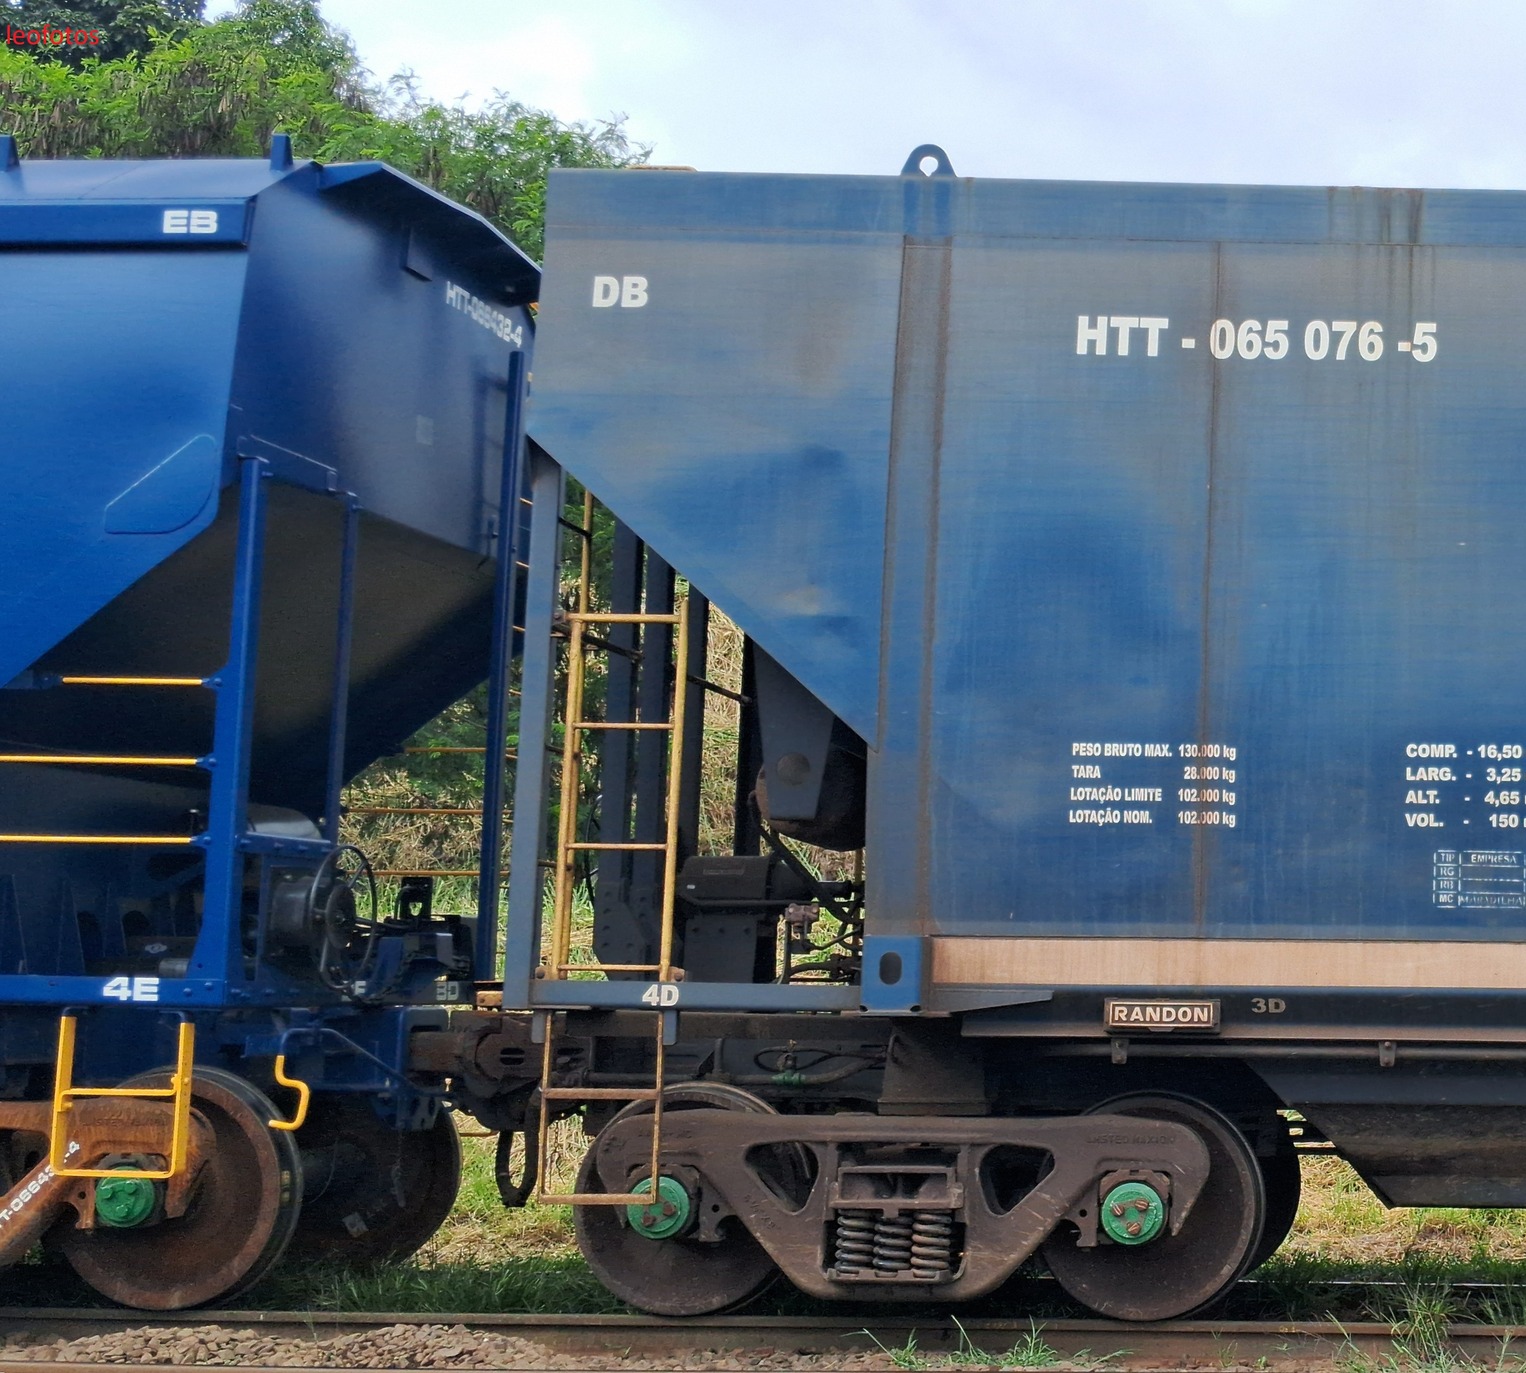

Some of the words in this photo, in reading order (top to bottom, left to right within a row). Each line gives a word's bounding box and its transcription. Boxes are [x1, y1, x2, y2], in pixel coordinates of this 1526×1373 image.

[163, 210, 217, 233] EB
[592, 276, 648, 307] DB
[1076, 316, 1169, 356] HTT
[1209, 319, 1289, 360] 065
[1304, 320, 1384, 361] 076
[1072, 743, 1101, 756] PESO
[1104, 743, 1142, 756] BRUTO
[1145, 744, 1172, 757] MAX.
[1179, 744, 1220, 758] 130.000
[1223, 745, 1236, 760] kg
[1406, 744, 1457, 758] COMP.
[1478, 745, 1522, 761] 16,50
[1072, 765, 1101, 778] TARA
[1184, 766, 1219, 780] 28.000
[1222, 767, 1236, 782] kg
[1406, 767, 1456, 781] LARG.
[1486, 768, 1521, 784] 3,25
[1071, 786, 1121, 803] LOTAÇÃO
[1124, 788, 1162, 801] LIMITE
[1178, 789, 1219, 802] 102.000
[1222, 790, 1236, 805] kg
[1405, 790, 1440, 804] ALT.
[1484, 791, 1519, 807] 4,65
[1069, 808, 1120, 826] LOTAÇÃO
[1123, 811, 1152, 823] NOM.
[1178, 811, 1219, 824] 102.000
[1222, 812, 1236, 827] kg
[1405, 813, 1444, 827] VOL.
[1489, 814, 1519, 828] 150
[1470, 854, 1517, 864] EMPRESA
[1440, 867, 1455, 876] RG
[1439, 894, 1454, 903] MC
[103, 977, 159, 1001] 4E
[642, 984, 679, 1006] 4D
[1114, 1006, 1209, 1022] RANDON
[1251, 998, 1286, 1014] 3D
